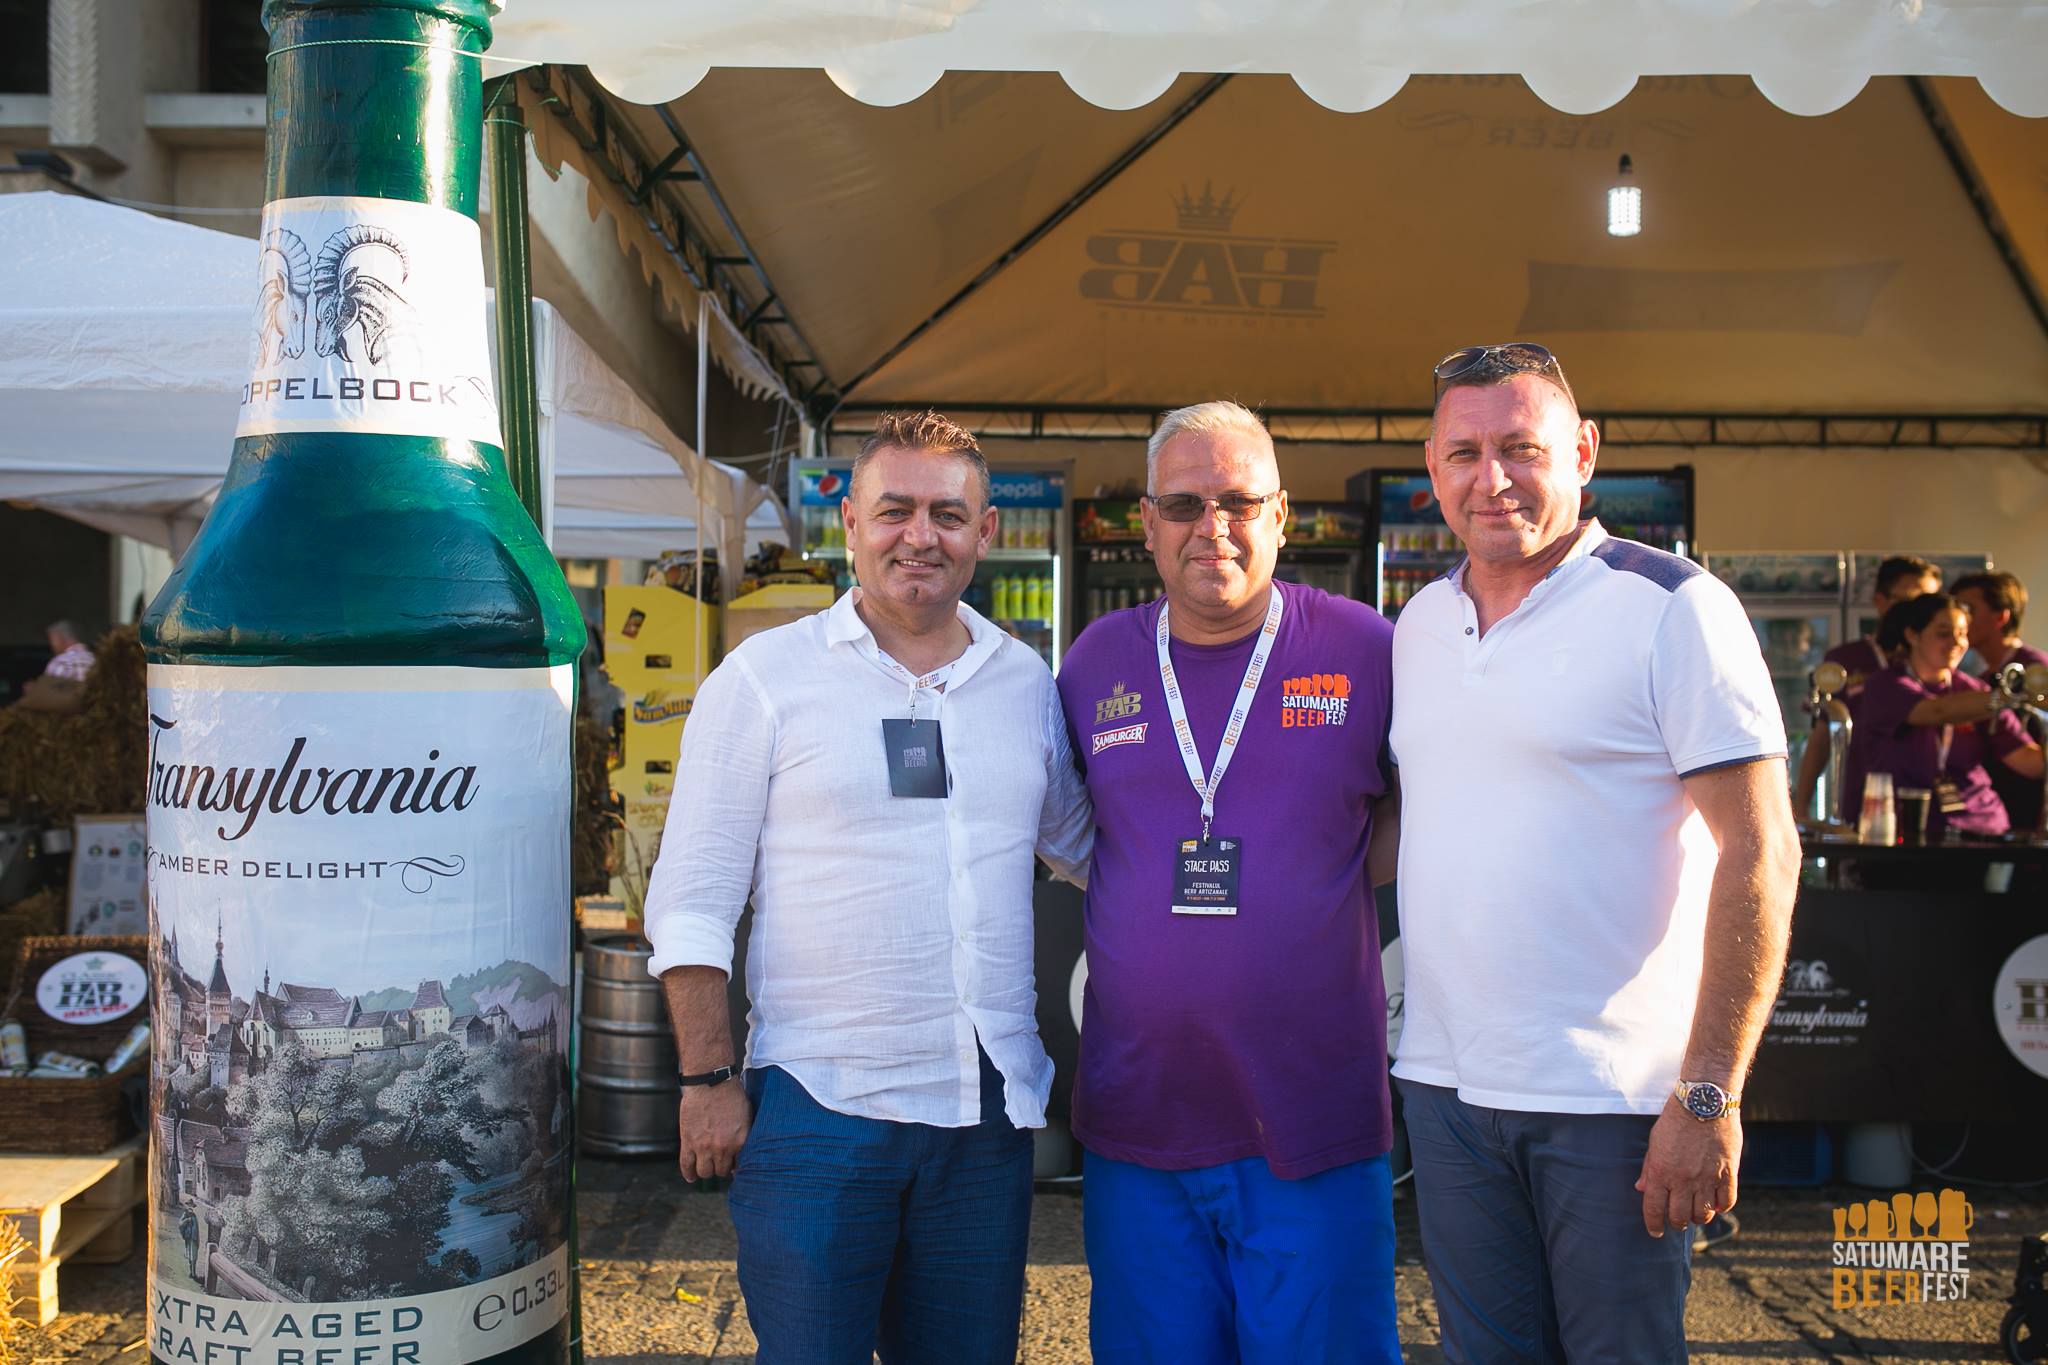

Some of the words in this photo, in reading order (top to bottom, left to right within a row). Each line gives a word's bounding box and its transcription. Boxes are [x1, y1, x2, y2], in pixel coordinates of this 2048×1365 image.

[241, 377, 458, 406] OPPELBOCK
[1244, 653, 1264, 689] BEERFEST
[1282, 695, 1350, 714] SATUMARE
[1094, 727, 1143, 751] SAMBURGER
[1175, 718, 1194, 755] BEERFEST
[1224, 708, 1243, 746] BEERFEST
[144, 713, 480, 841] Transylvania
[158, 852, 229, 876] AMBER
[242, 860, 388, 879] DELIGHT
[1184, 860, 1208, 873] STAGE
[1209, 860, 1230, 873] PASS
[513, 1270, 565, 1316] 0.33L
[153, 1288, 249, 1336] XTRA
[272, 1306, 424, 1339] AGED
[153, 1323, 252, 1365] RAFT
